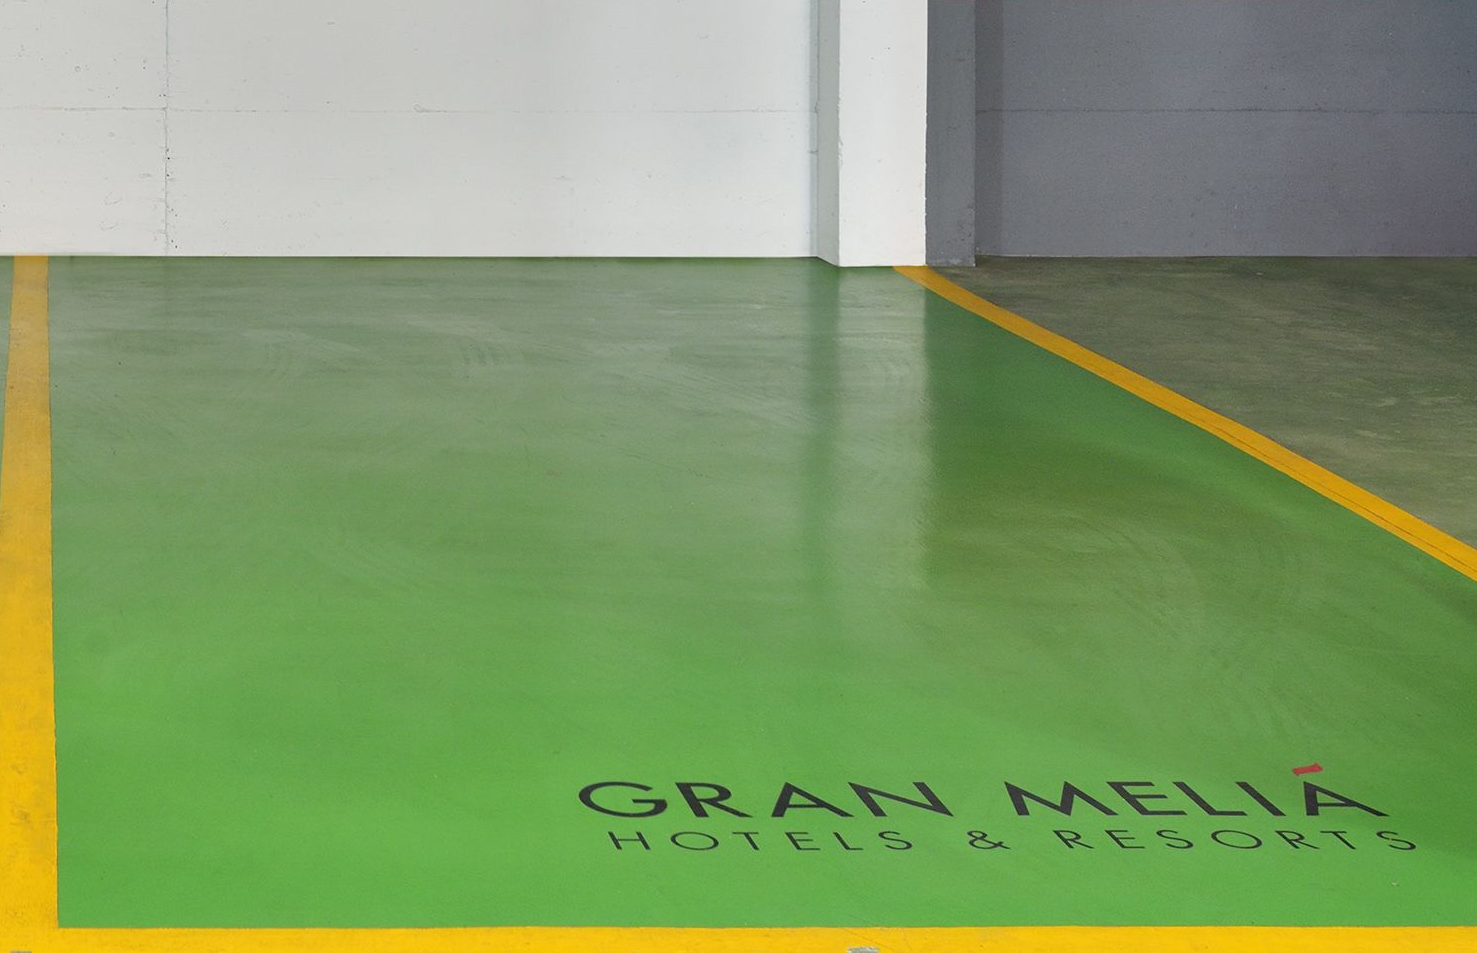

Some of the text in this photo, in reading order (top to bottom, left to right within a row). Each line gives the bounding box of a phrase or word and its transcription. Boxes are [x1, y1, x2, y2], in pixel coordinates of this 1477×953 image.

[578, 764, 1388, 818] GRAN MELIÁ
[609, 829, 1416, 851] HOTELS & RESORTS
